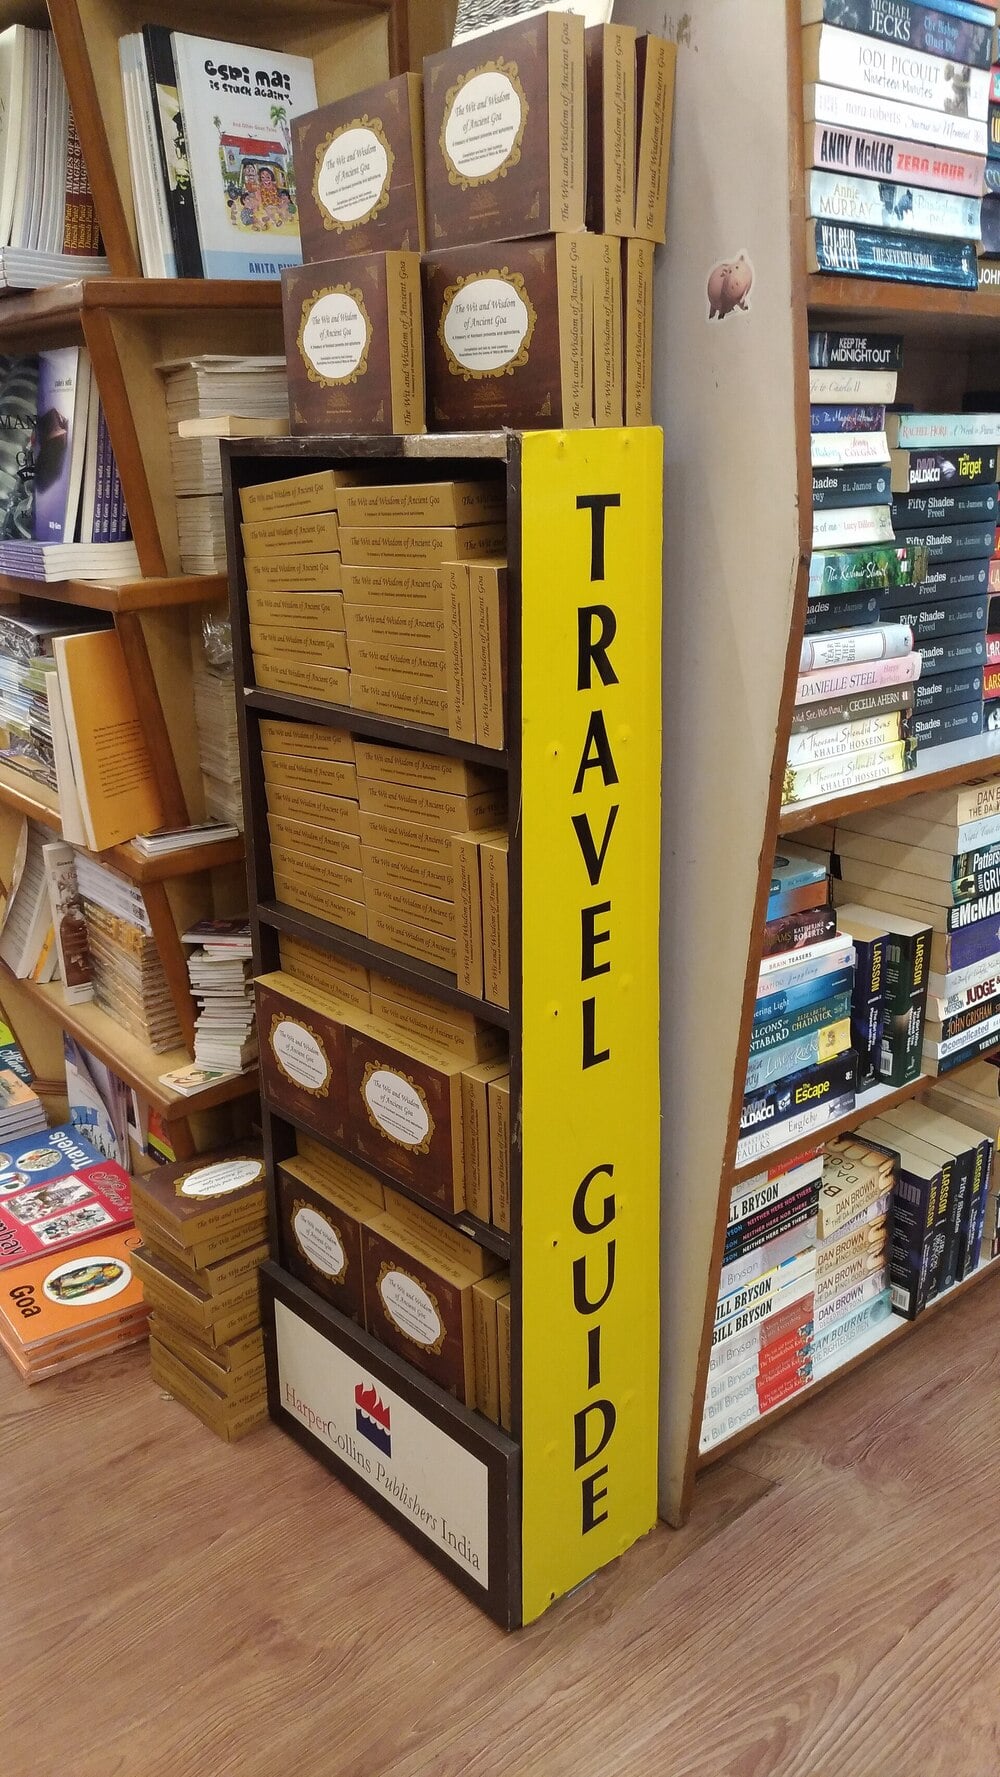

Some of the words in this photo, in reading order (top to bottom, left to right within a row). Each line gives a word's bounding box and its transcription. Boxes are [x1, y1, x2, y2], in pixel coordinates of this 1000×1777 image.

[870, 0, 911, 20] MICHAEL
[561, 22, 569, 45] Goa
[869, 11, 910, 41] JECKS
[560, 49, 569, 92] Ancient
[859, 46, 885, 68] JODI
[892, 56, 940, 84] PICOULT
[864, 68, 899, 91] Nineteen
[466, 102, 475, 113] Wit
[477, 96, 487, 109] and
[489, 91, 510, 104] Wisdom
[562, 94, 570, 111] of
[468, 116, 489, 131] Ancient
[491, 112, 501, 125] Goa
[559, 117, 568, 156] Wisdom
[68, 141, 74, 156] OF
[821, 131, 852, 164] ANDY
[855, 138, 893, 174] McNAB
[561, 158, 569, 177] and
[897, 154, 929, 172] ZERO
[560, 180, 569, 199] Wit
[834, 183, 859, 200] Annie
[561, 203, 569, 222] The
[820, 196, 872, 218] MURRAY
[822, 225, 855, 247] WILBUR
[249, 262, 276, 274] ANITA
[823, 245, 859, 269] SMITH
[885, 248, 913, 267] SEVENTH
[914, 252, 933, 267] SCROLL
[455, 303, 464, 313] The
[466, 302, 478, 312] Wit
[479, 300, 491, 311] and
[492, 298, 515, 309] Wisdom
[464, 318, 470, 330] of
[470, 317, 493, 328] Ancient
[495, 316, 506, 327] Goa
[839, 338, 855, 349] KEEP
[855, 339, 867, 350] THE
[831, 349, 871, 362] MIDNIGHT
[872, 350, 891, 362] OUT
[845, 448, 877, 457] COLGAN
[917, 458, 935, 469] DAVID
[910, 468, 940, 484] BALDACCI
[959, 458, 982, 479] Target
[813, 477, 838, 488] hades
[852, 483, 872, 491] James
[908, 499, 926, 510] Fifty
[928, 497, 954, 508] Shades
[928, 509, 945, 518] Freed
[825, 566, 838, 582] The
[840, 564, 866, 581] Kashmir
[482, 632, 488, 644] of
[481, 646, 489, 680] Wisdom
[826, 644, 834, 663] YEAR
[801, 675, 847, 697] DANIELLE
[849, 672, 877, 688] STEEL
[849, 699, 876, 712] CECELIA
[877, 691, 900, 706] AHERN
[808, 731, 838, 751] Thousand
[840, 723, 870, 743] Splendid
[814, 743, 846, 759] KHALED
[850, 734, 885, 749] HOSSEINI
[571, 494, 620, 1069] TRAVEL
[978, 791, 994, 805] DAN
[969, 807, 982, 819] THE
[794, 921, 824, 934] KATHERINE
[794, 928, 824, 942] ROBERTS
[769, 961, 786, 970] BRAIN
[789, 952, 812, 963] TEASERS
[871, 942, 882, 992] LARSSON
[966, 980, 996, 1005] JUDGE
[792, 1009, 832, 1032] CHADWICK
[798, 1006, 826, 1020] ELIZABETH
[947, 1017, 964, 1036] JOHN
[966, 1002, 992, 1027] GRISHAM
[750, 1028, 789, 1052] NTABARD
[751, 1019, 782, 1039] ALCONS
[795, 1080, 830, 1105] Escape
[740, 1104, 774, 1128] ALDACCI
[788, 1111, 818, 1132] Engleby
[49, 1131, 92, 1172] Travels
[737, 1139, 770, 1160] FAULKS
[742, 1182, 779, 1216] BRYSON
[836, 1196, 850, 1214] DAN
[851, 1178, 875, 1201] BROWN
[926, 1178, 938, 1228] LARSSON
[742, 1235, 765, 1253] NEITHER
[766, 1228, 779, 1240] HERE
[780, 1222, 791, 1232] NOR
[792, 1213, 808, 1225] THERE
[817, 1278, 833, 1295] DAN
[835, 1258, 863, 1283] BROWN
[9, 1285, 42, 1318] Goa
[717, 1300, 731, 1320] ILL
[734, 1277, 772, 1310] BRYSON
[712, 1322, 733, 1346] BILL
[736, 1298, 773, 1332] BRYSON
[811, 1336, 829, 1354] SAM
[831, 1307, 868, 1338] BOURNE
[570, 1164, 617, 1532] GUIDE
[711, 1354, 725, 1369] Bill
[726, 1337, 757, 1361] Bryson
[286, 1383, 371, 1473] HarperCollins
[376, 1461, 437, 1530] Publishers
[441, 1517, 480, 1570] India
